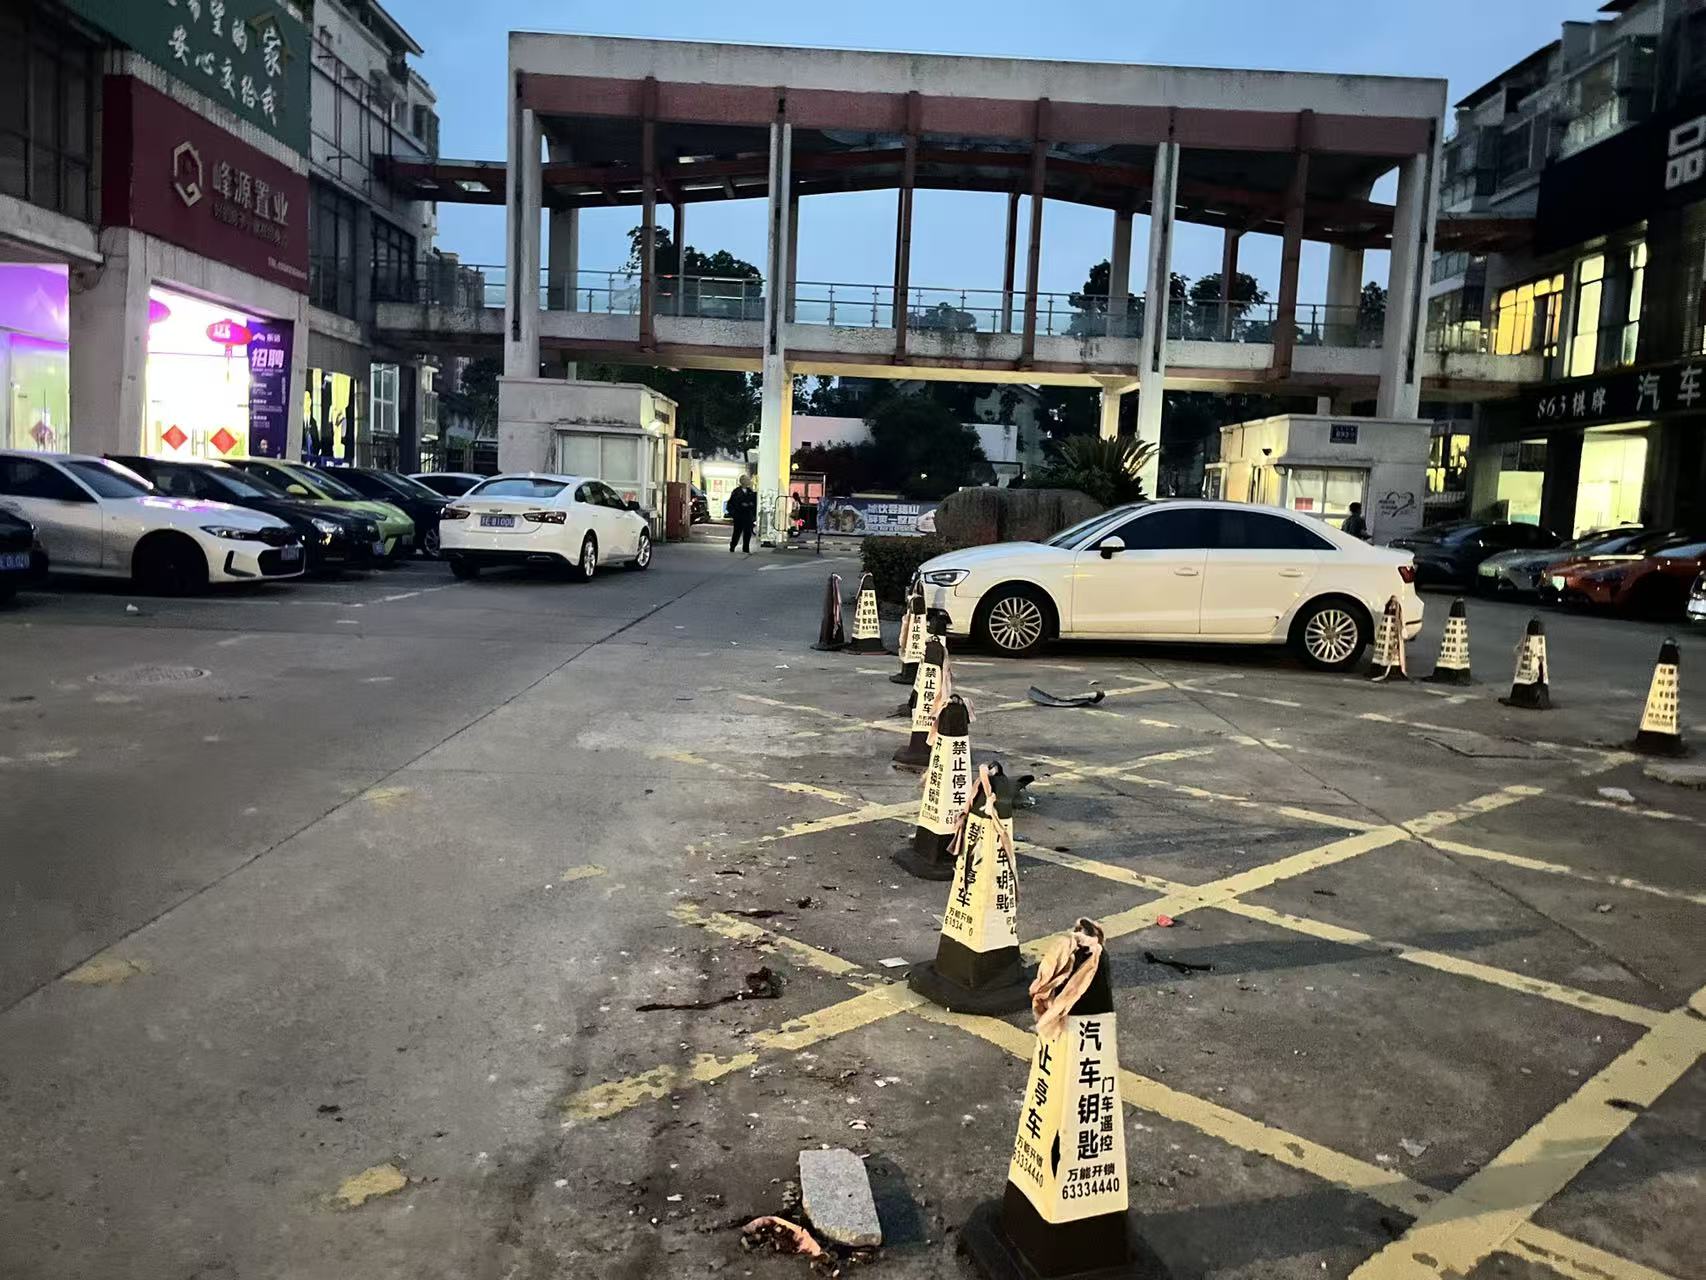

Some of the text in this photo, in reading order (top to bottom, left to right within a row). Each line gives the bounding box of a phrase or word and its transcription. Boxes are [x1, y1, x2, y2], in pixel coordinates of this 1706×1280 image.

[212, 160, 289, 227] 峰源置业
[252, 348, 285, 368] 招聘
[922, 666, 937, 714] 禁止停车
[952, 740, 967, 806] 禁止停车
[1077, 1020, 1102, 1161] 汽车钥匙
[1099, 1076, 1115, 1152] 门车遥控
[1062, 1177, 1121, 1200] 63334440
[1066, 1163, 1116, 1183] 万能开锁
